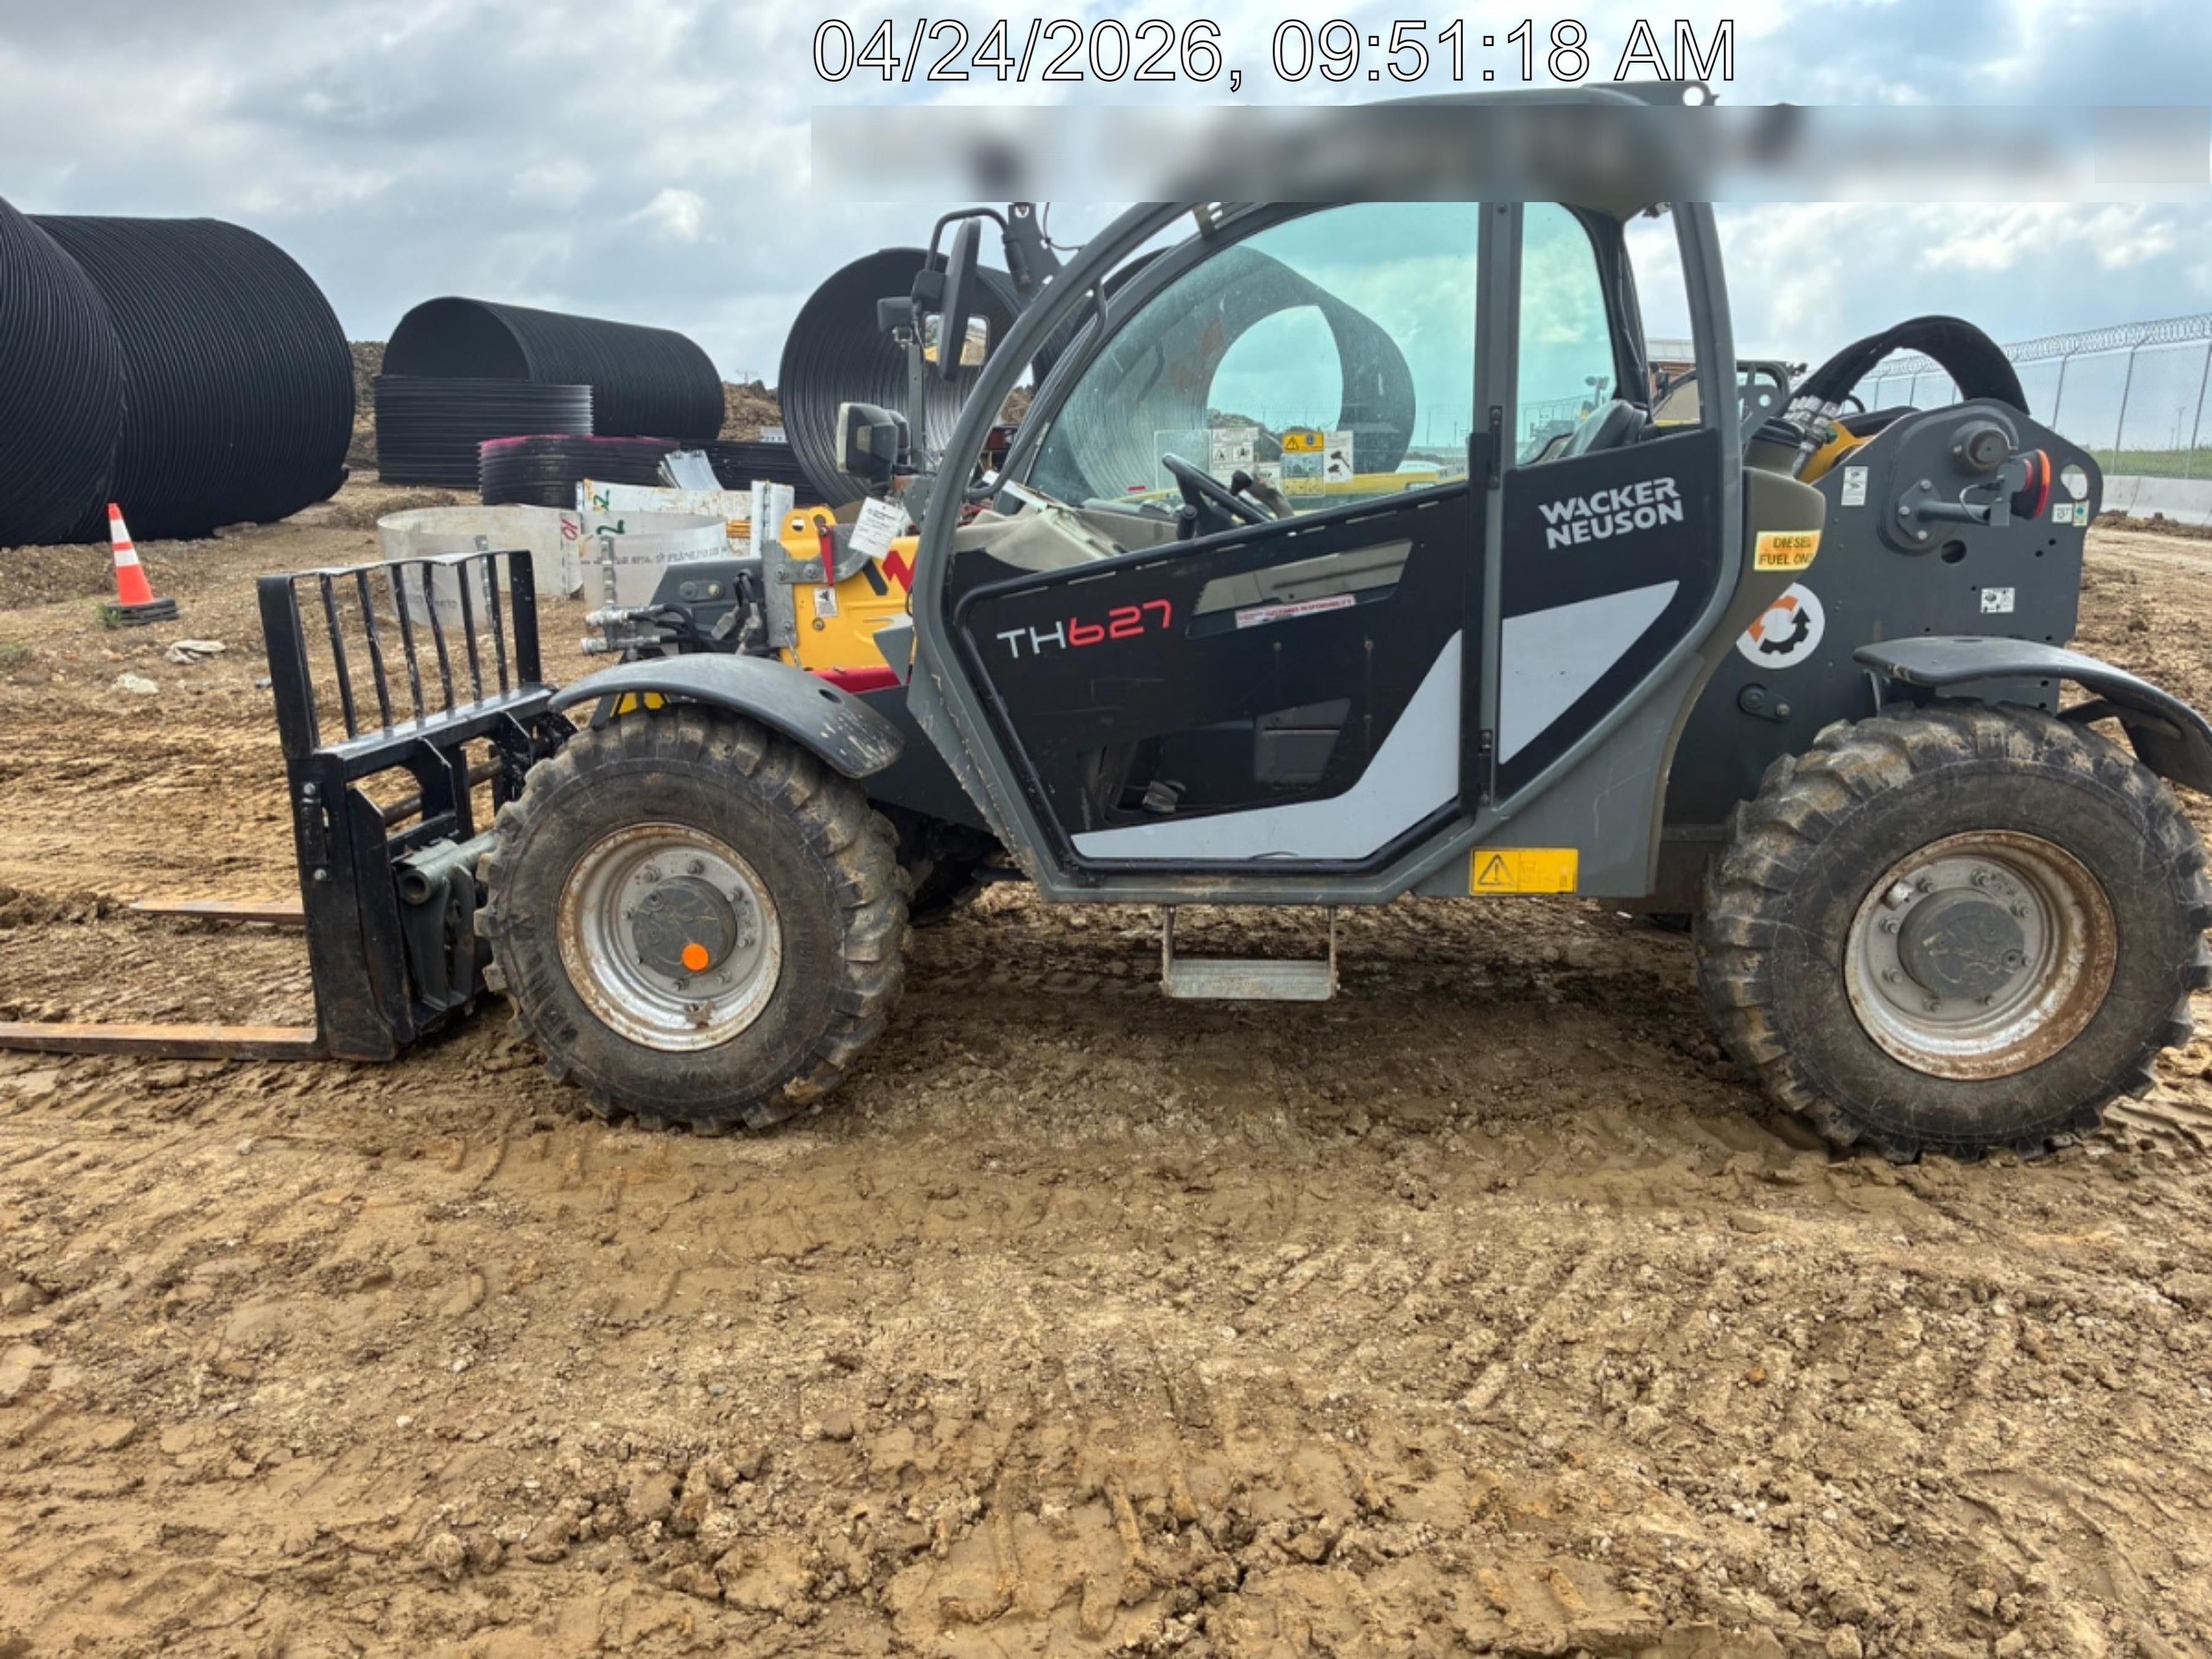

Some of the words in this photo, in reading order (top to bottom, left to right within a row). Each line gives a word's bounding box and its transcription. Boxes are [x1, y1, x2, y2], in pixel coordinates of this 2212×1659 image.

[1538, 477, 1681, 524] WACKER
[1546, 500, 1684, 549] NEUSON
[1773, 536, 1811, 548] DIESEL
[1759, 553, 1790, 565] FUEL
[997, 598, 1172, 659] TH627
